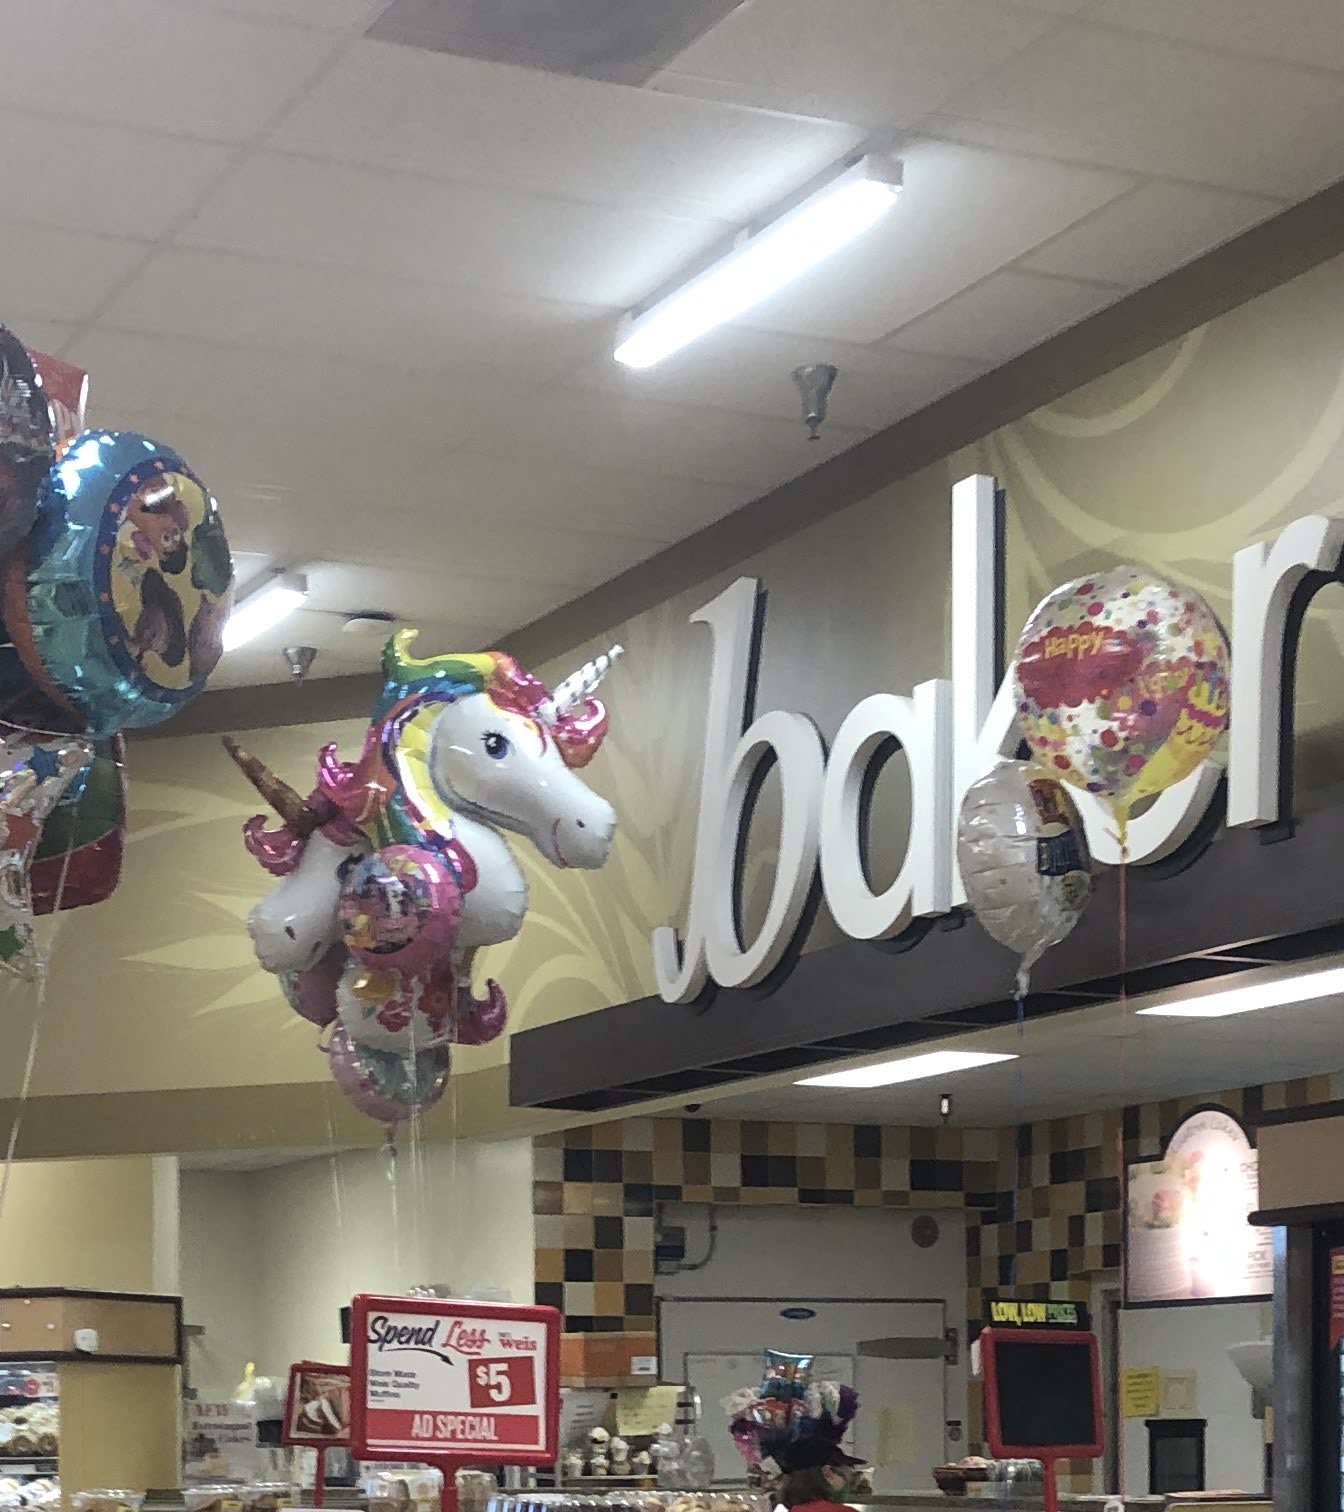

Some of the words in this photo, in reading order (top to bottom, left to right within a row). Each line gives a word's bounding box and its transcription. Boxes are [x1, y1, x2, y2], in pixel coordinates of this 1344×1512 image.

[1044, 631, 1105, 660] Happy
[367, 1315, 441, 1352] Spend
[440, 1319, 492, 1356] Less
[475, 1362, 513, 1402] $5
[411, 1413, 434, 1438] AD
[435, 1415, 499, 1441] SPECIAL
